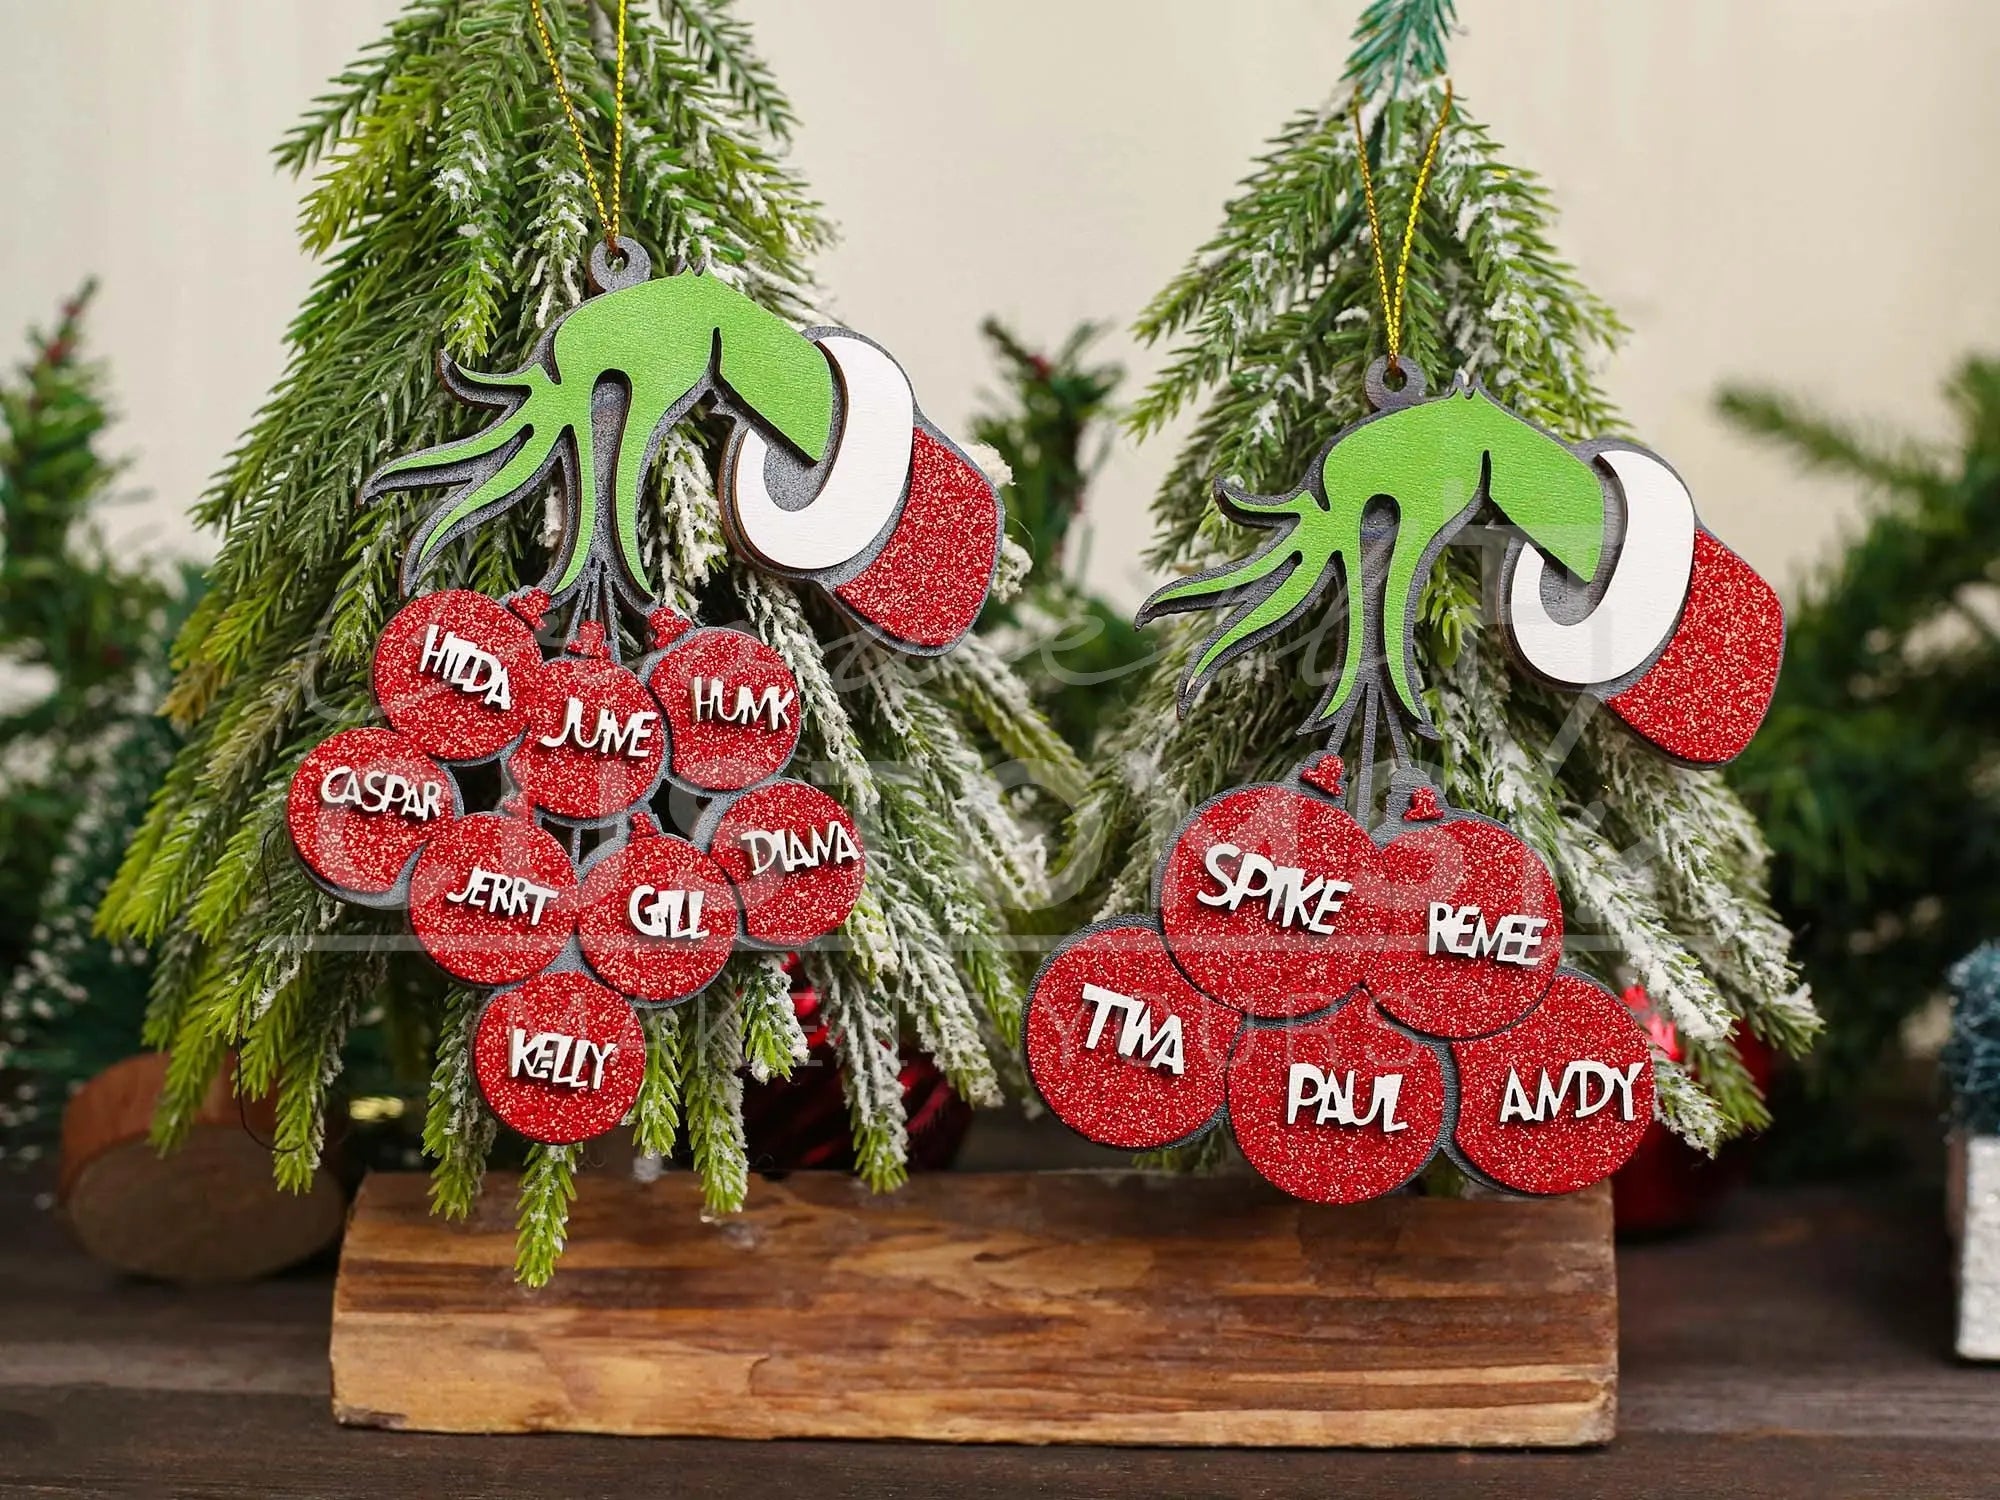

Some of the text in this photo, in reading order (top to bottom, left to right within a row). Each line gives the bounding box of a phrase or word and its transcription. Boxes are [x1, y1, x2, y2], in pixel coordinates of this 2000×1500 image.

[419, 623, 512, 710] HILDA
[540, 694, 658, 757] JUNE
[321, 765, 442, 821] CASPAR
[740, 820, 862, 876] DIANA
[629, 884, 710, 940] GILL
[1196, 841, 1353, 935] SPIKE
[1428, 901, 1549, 966] RENEE
[511, 1028, 619, 1090] KELLY
[1082, 982, 1185, 1075] TINA
[1287, 1062, 1409, 1132] PAUL
[1499, 1055, 1645, 1122] ANDY
